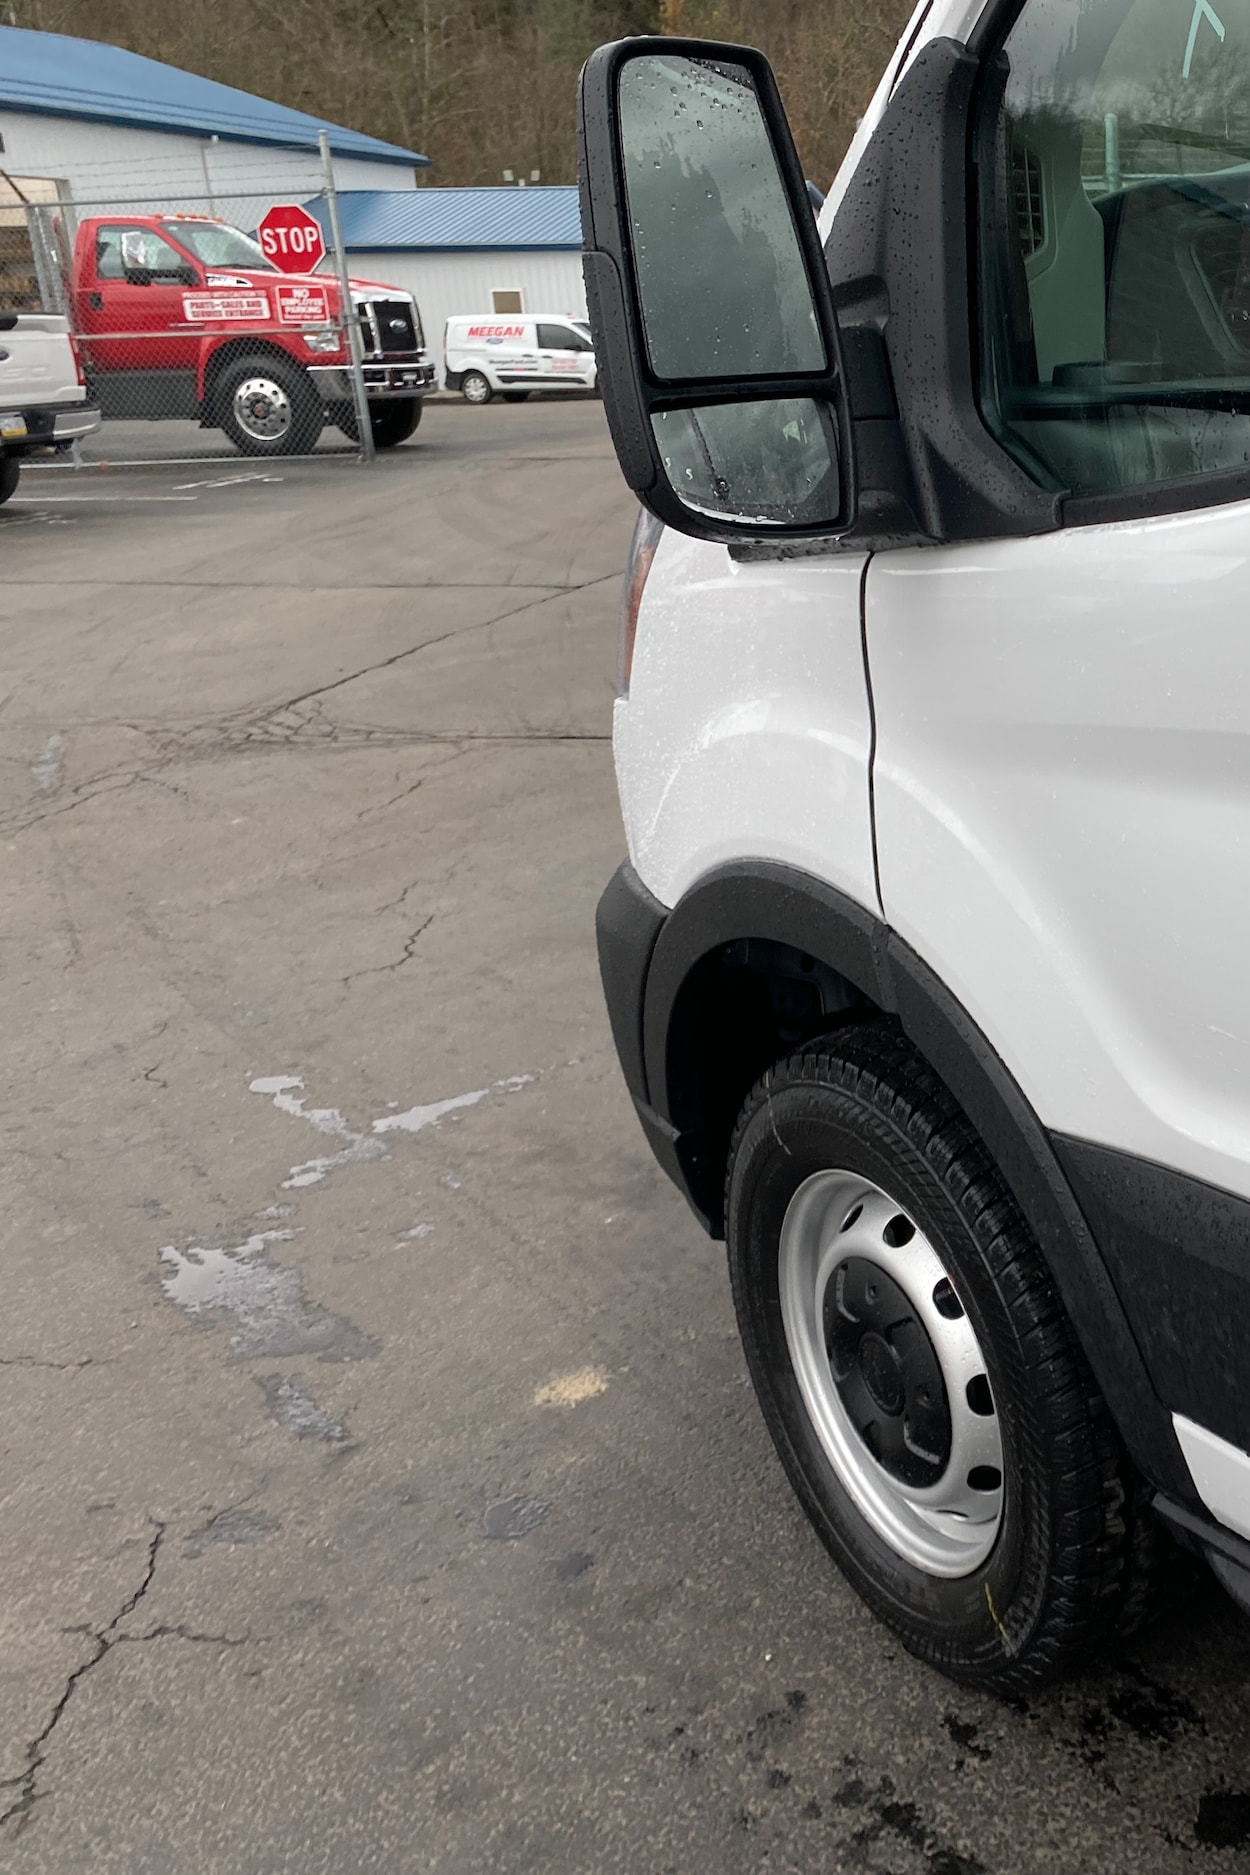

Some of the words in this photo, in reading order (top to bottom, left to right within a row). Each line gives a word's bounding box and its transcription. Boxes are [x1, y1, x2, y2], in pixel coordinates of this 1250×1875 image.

[262, 227, 318, 254] STOP
[292, 288, 310, 298] NO
[280, 297, 323, 306] EMPLOYEE
[284, 305, 322, 314] PARKING
[467, 326, 525, 337] MEEGAN
